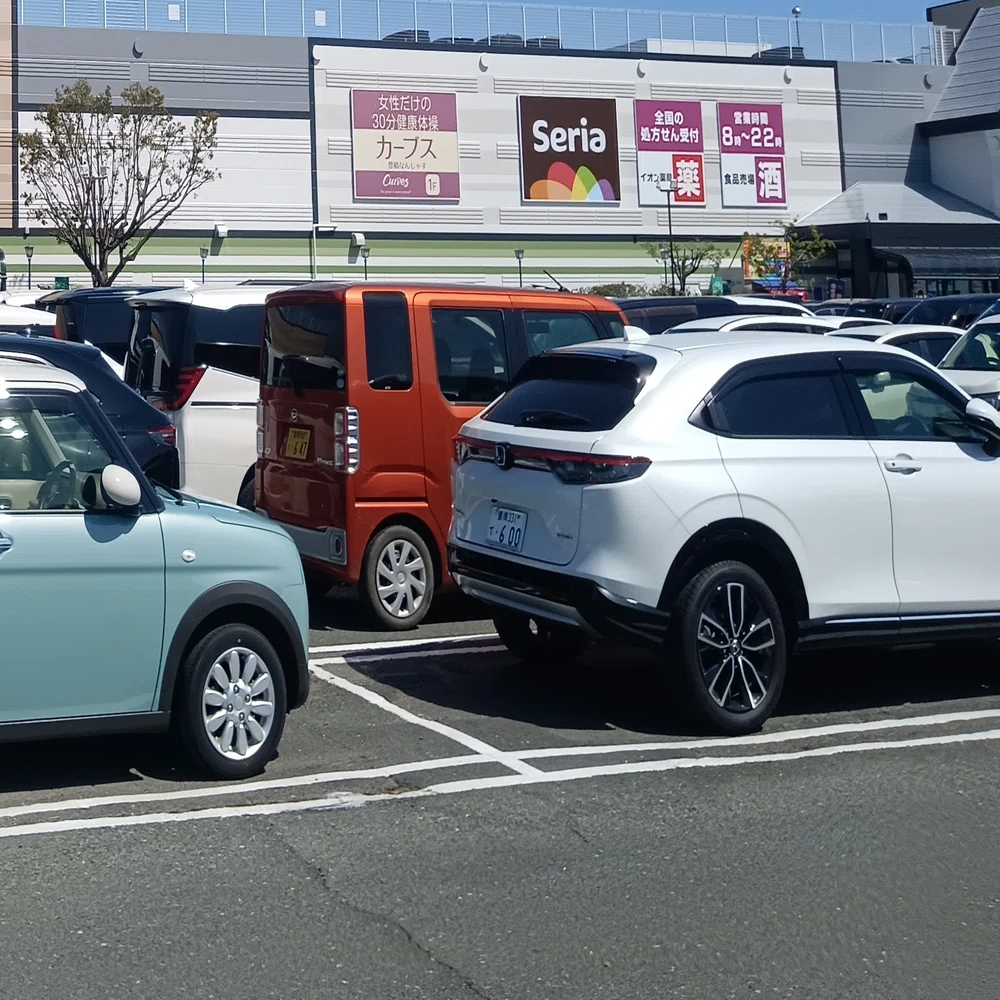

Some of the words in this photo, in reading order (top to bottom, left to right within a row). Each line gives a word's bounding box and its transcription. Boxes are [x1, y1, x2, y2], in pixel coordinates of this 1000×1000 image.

[378, 94, 431, 111] 女性だけの
[372, 113, 439, 131] 30分健康体操
[654, 110, 684, 125] 全国の
[532, 117, 606, 153] Seria
[640, 126, 699, 143] 処方せん受付
[376, 135, 437, 159] カーブス
[428, 178, 437, 191] 1F
[676, 160, 701, 197] 薬
[758, 161, 782, 198] 酒
